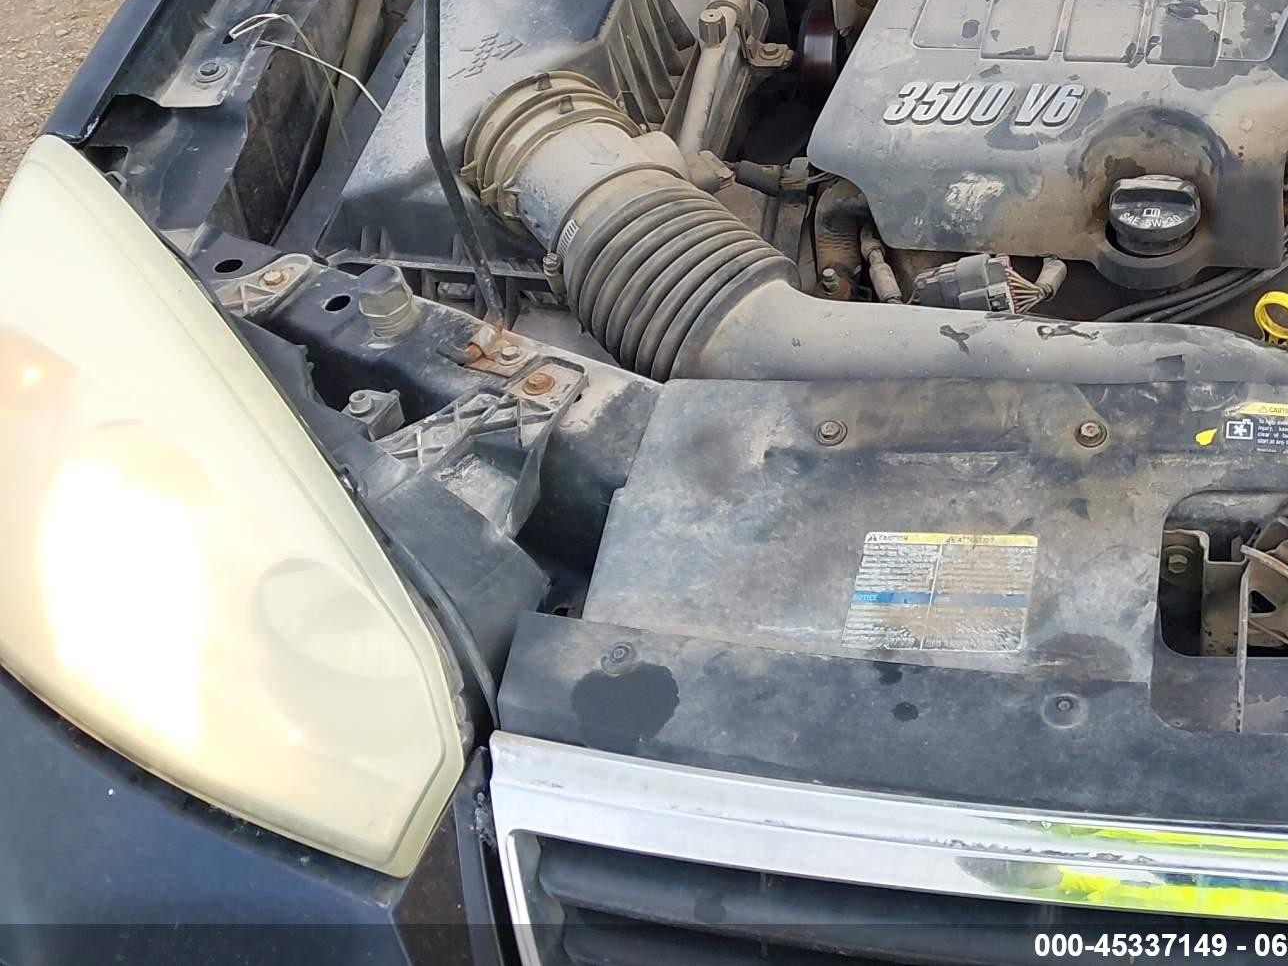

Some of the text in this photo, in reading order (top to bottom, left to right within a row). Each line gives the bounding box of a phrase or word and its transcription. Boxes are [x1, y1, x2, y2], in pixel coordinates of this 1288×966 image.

[883, 81, 1085, 127] 3500 V6
[1119, 212, 1182, 227] SAE 5W-30
[853, 593, 879, 601] NOTICE
